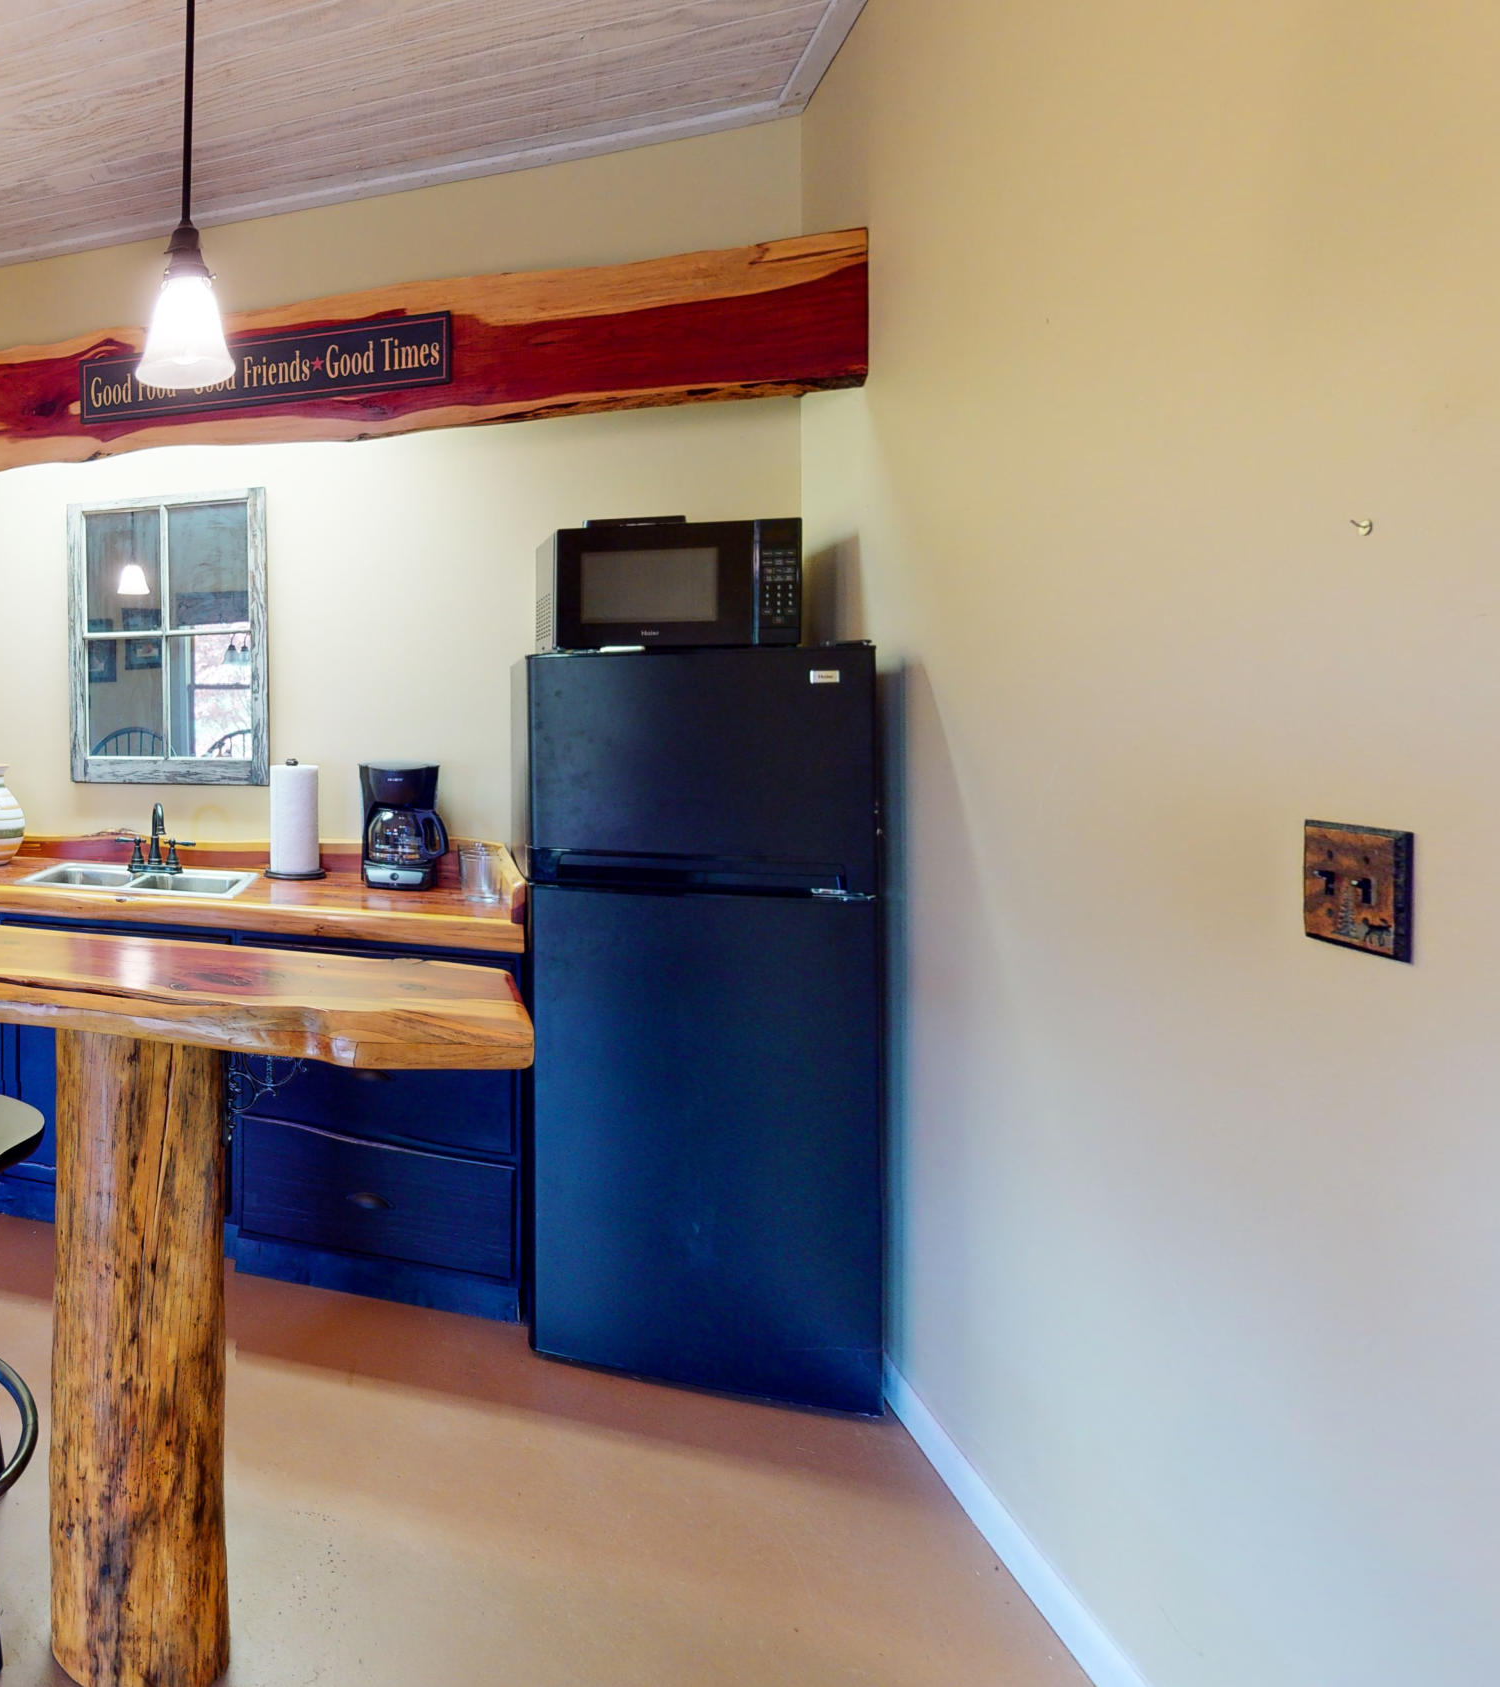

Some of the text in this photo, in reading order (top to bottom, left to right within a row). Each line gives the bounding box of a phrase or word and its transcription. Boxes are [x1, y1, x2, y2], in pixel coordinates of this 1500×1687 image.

[90, 373, 132, 408] Good
[243, 350, 310, 388] Friends
[325, 341, 375, 379] Good
[381, 336, 440, 372] Times
